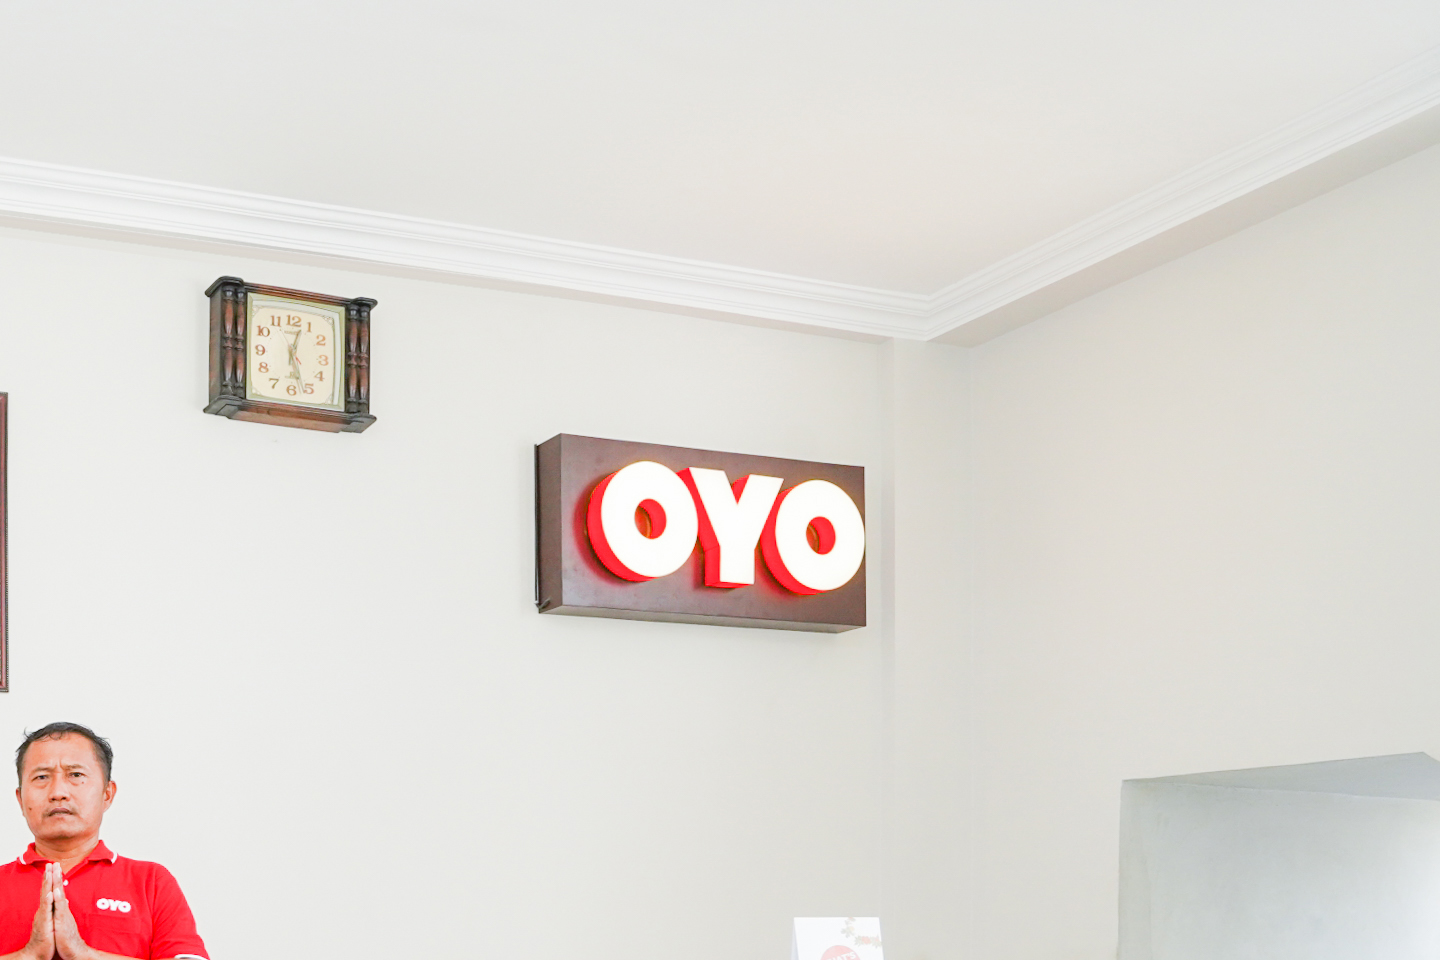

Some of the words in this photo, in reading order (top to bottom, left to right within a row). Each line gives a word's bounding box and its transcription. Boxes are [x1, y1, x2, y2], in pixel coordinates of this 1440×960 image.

[270, 315, 281, 327] 11
[286, 315, 302, 328] 12
[256, 325, 270, 337] 10
[307, 322, 312, 333] 1
[316, 334, 326, 346] 2
[255, 344, 265, 356] 9
[318, 355, 329, 366] 3
[258, 362, 269, 373] 8
[314, 371, 325, 381] 4
[268, 378, 279, 389] 7
[304, 383, 314, 394] 5
[286, 385, 297, 396] 6
[588, 460, 865, 595] OYO
[96, 898, 131, 913] OYO
